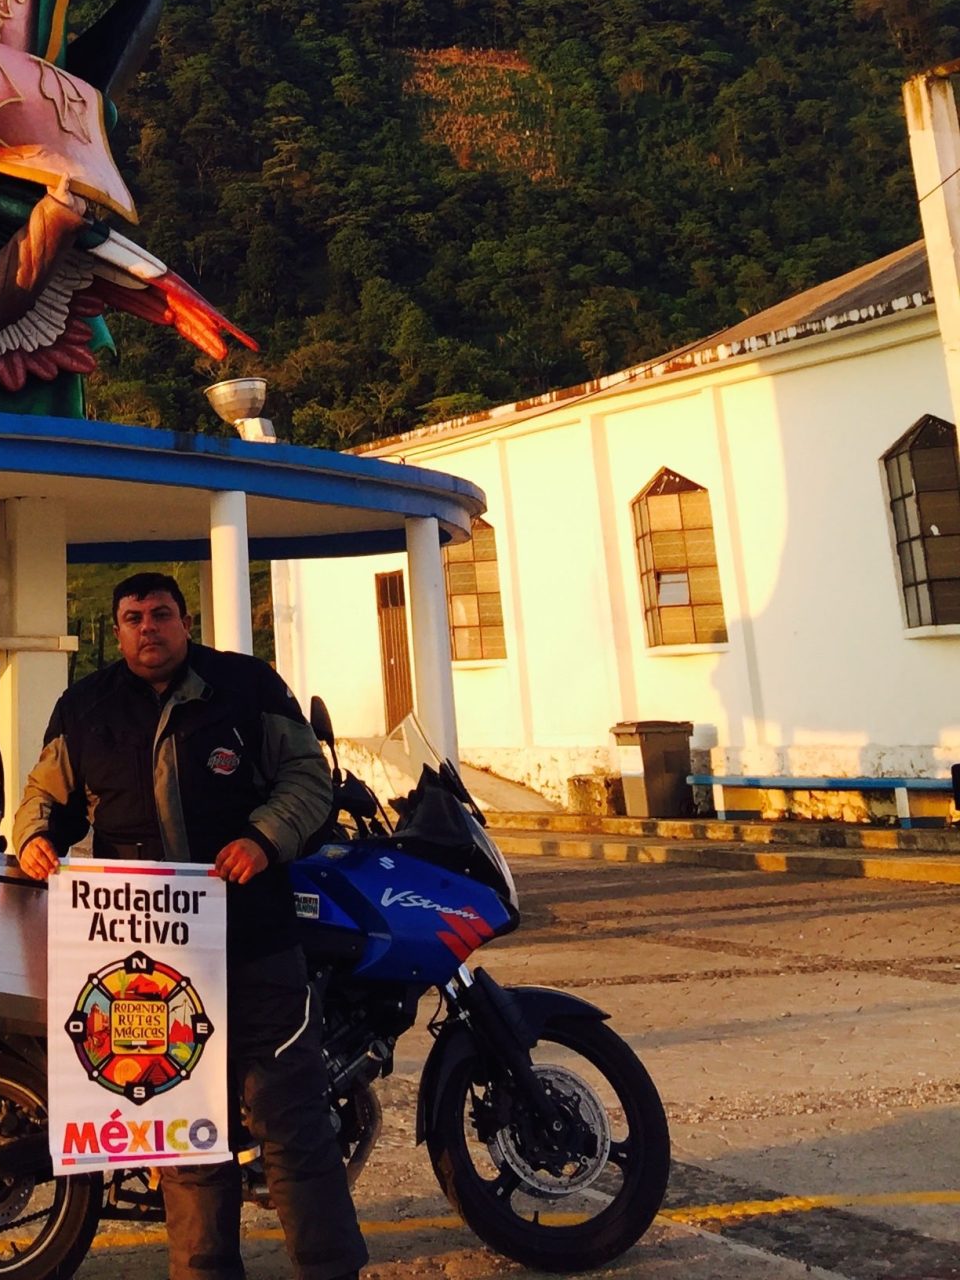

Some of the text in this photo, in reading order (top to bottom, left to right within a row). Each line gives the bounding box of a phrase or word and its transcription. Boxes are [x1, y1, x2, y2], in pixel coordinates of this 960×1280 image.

[71, 880, 207, 914] Rodador
[380, 887, 480, 920] V-Strom
[88, 912, 190, 946] Activo
[132, 957, 147, 970] N
[196, 1022, 209, 1034] E
[133, 1087, 147, 1099] S
